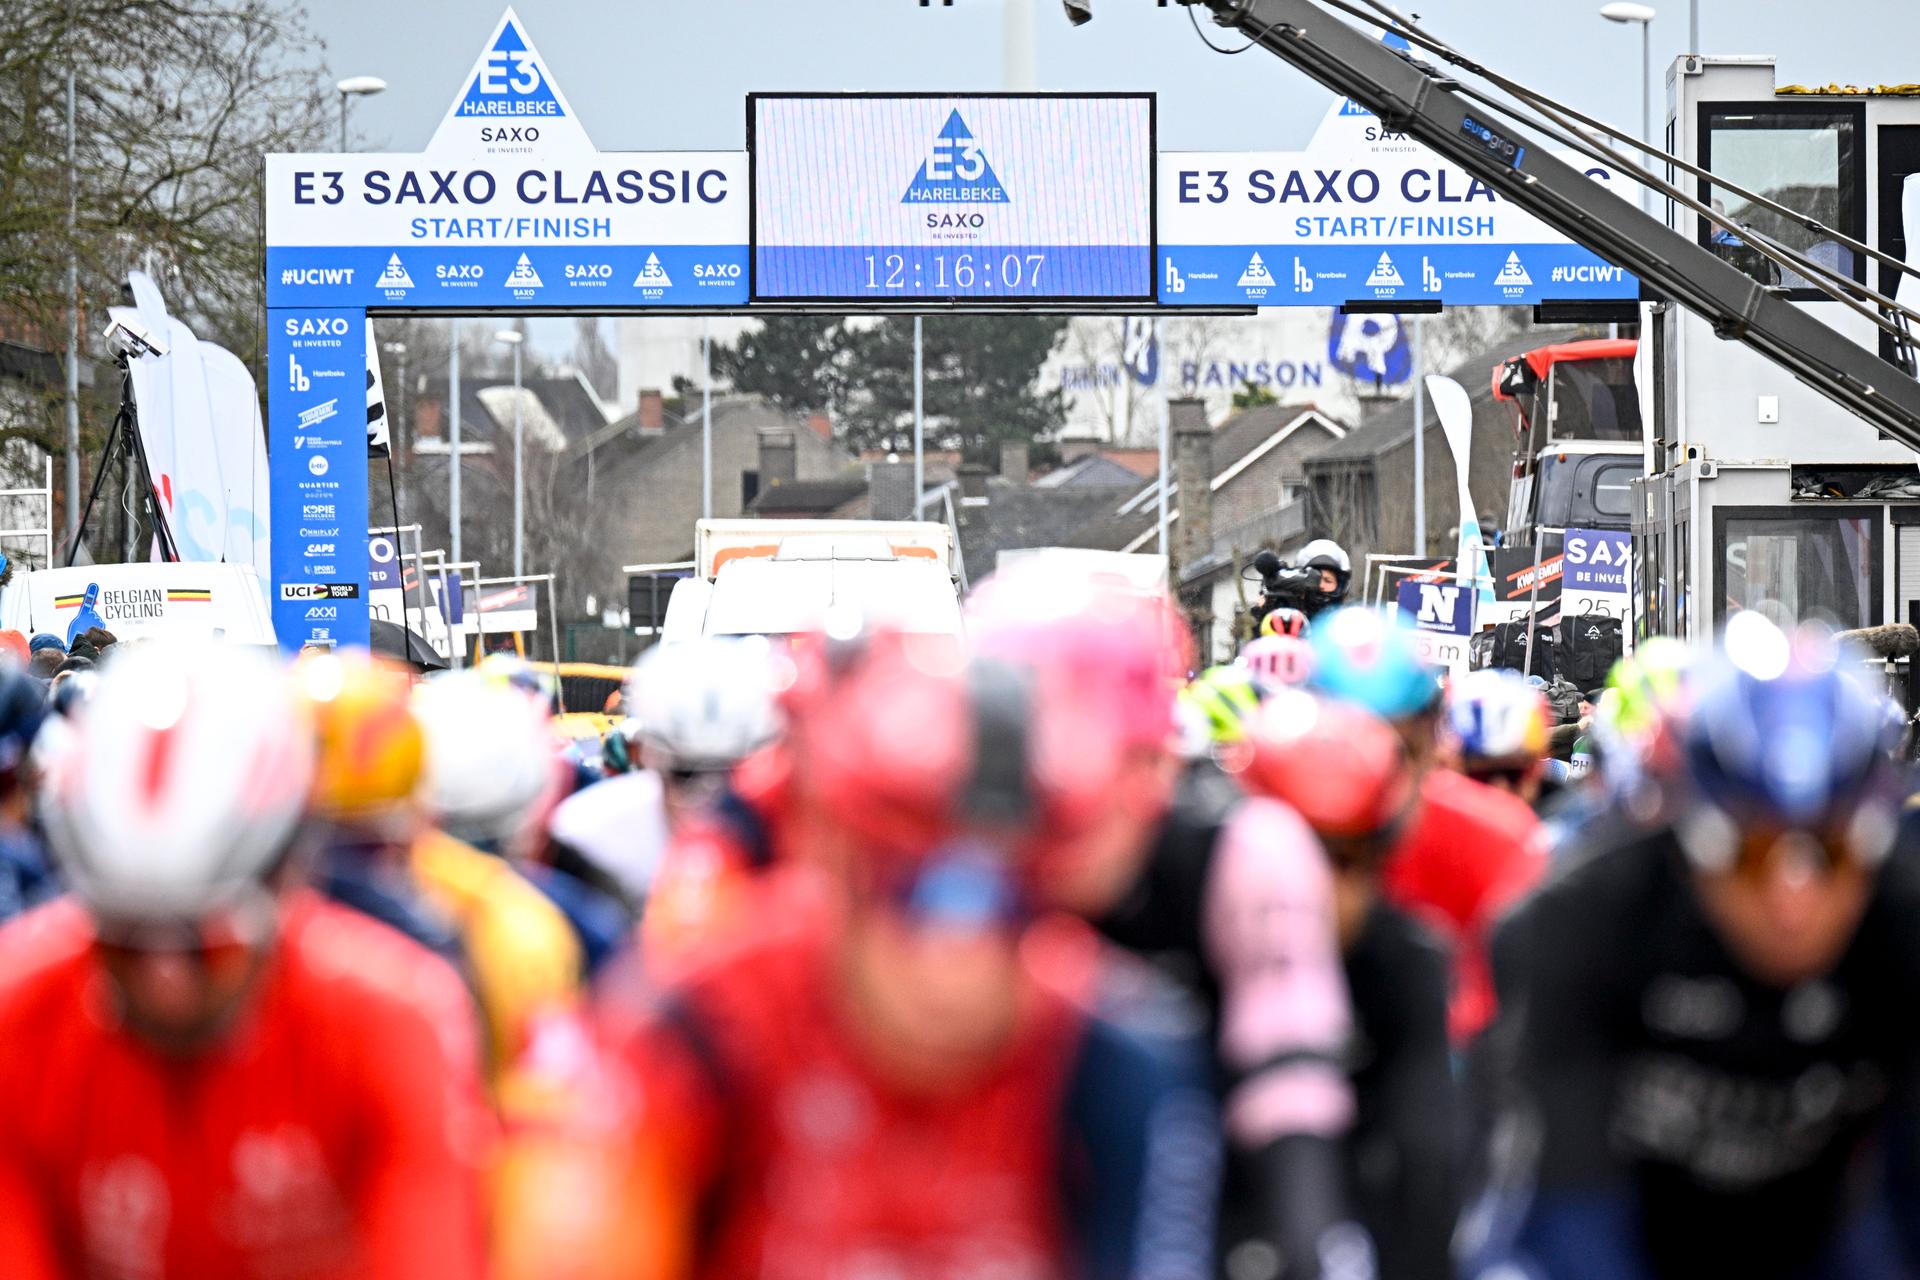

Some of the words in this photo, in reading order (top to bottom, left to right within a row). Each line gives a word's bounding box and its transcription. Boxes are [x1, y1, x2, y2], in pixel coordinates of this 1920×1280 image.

[480, 51, 540, 94] E3
[464, 101, 556, 114] HARELBEKE
[481, 127, 540, 142] SAXO
[925, 138, 985, 180] E3
[294, 171, 345, 205] E3
[363, 169, 497, 205] SAXO
[516, 169, 729, 204] CLASSIC
[909, 187, 1001, 201] HARELBEKE
[1178, 170, 1229, 204] E3
[1248, 169, 1380, 204] SAXO
[411, 217, 612, 239] START/FINISH
[926, 213, 985, 228] SAXO
[1295, 216, 1494, 238] START/FINISH
[281, 269, 355, 285] #UCIWT
[436, 265, 484, 279] SAXO
[565, 264, 613, 278] SAXO
[693, 264, 741, 278] SAXO
[864, 254, 1045, 288] 12:16:07
[1551, 266, 1624, 283] #UCIWT
[384, 289, 406, 297] SAXO
[642, 288, 664, 296] SAXO
[286, 318, 349, 336] SAXO
[292, 340, 302, 348] BE
[1181, 361, 1322, 388] RANSON
[303, 505, 336, 514] KOPIE
[308, 544, 335, 552] CAPS
[1576, 572, 1591, 582] BE
[104, 589, 162, 604] BELGIAN
[285, 587, 311, 597] UCI
[105, 603, 163, 619] CYCLING
[1417, 584, 1460, 624] N
[305, 607, 336, 617] AXXI
